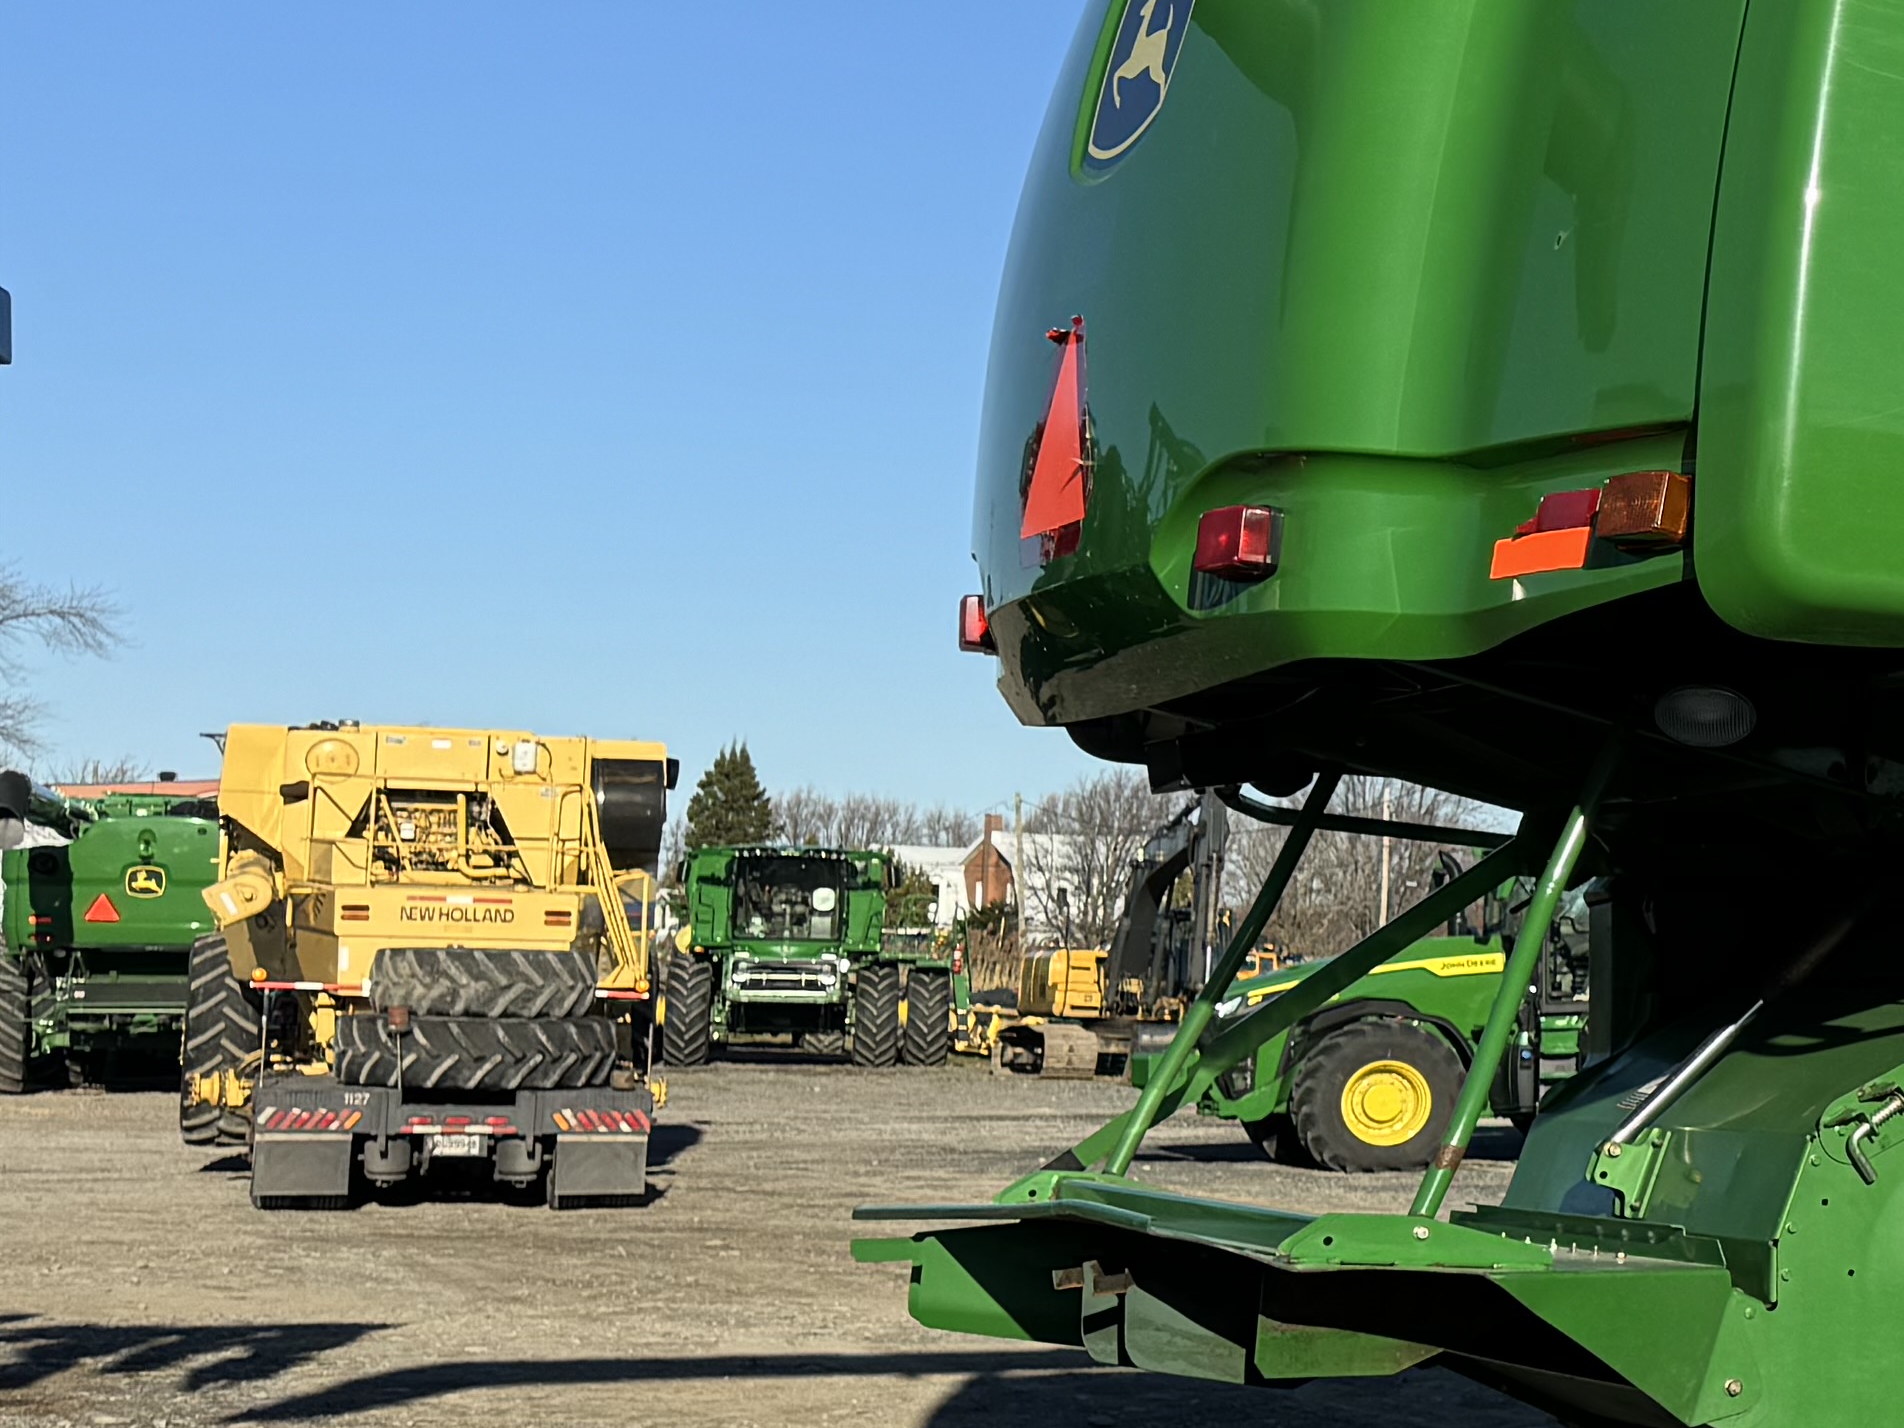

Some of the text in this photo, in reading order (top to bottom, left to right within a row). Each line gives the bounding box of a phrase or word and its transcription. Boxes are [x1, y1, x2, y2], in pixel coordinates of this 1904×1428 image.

[400, 905, 515, 924] NEW HOLLAND
[343, 1091, 371, 1106] 1127
